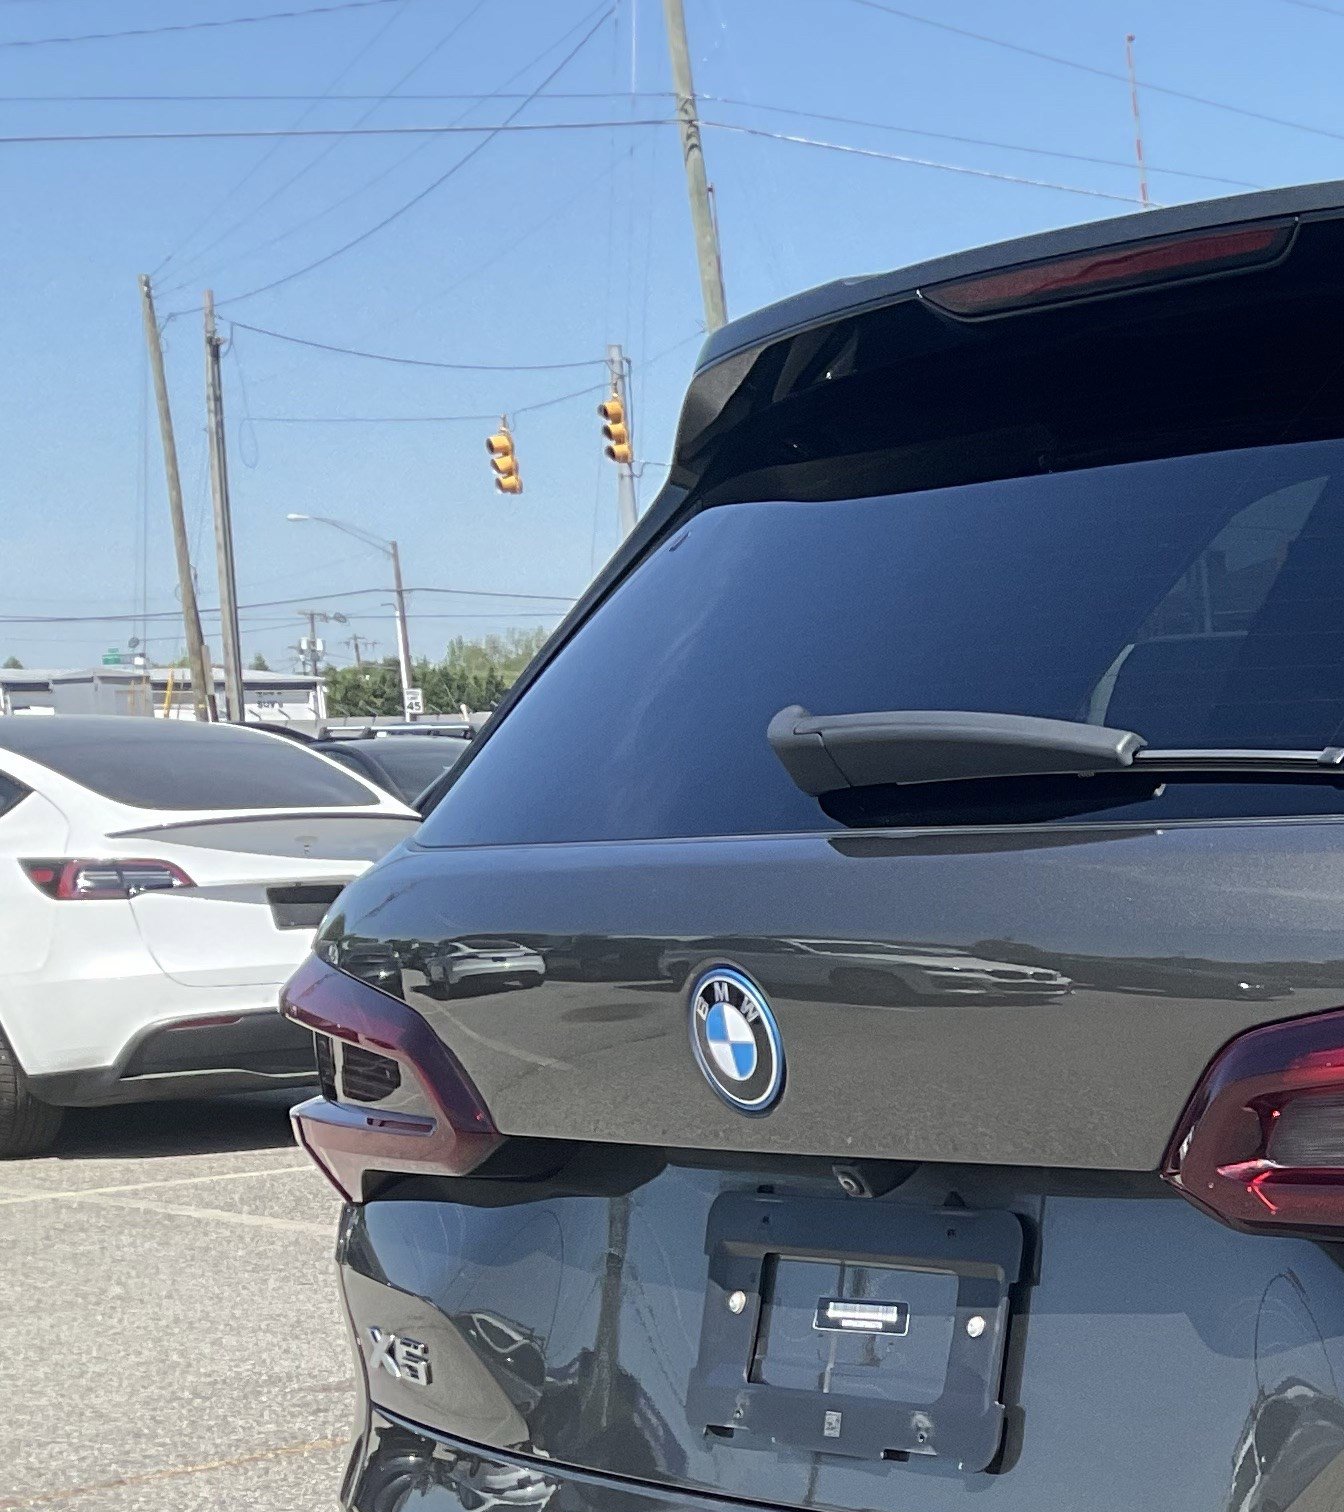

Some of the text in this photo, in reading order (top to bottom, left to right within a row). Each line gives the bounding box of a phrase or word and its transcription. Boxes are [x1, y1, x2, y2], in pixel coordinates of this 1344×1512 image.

[407, 701, 421, 711] 45
[696, 981, 760, 1022] BMW
[369, 1327, 429, 1386] X5
